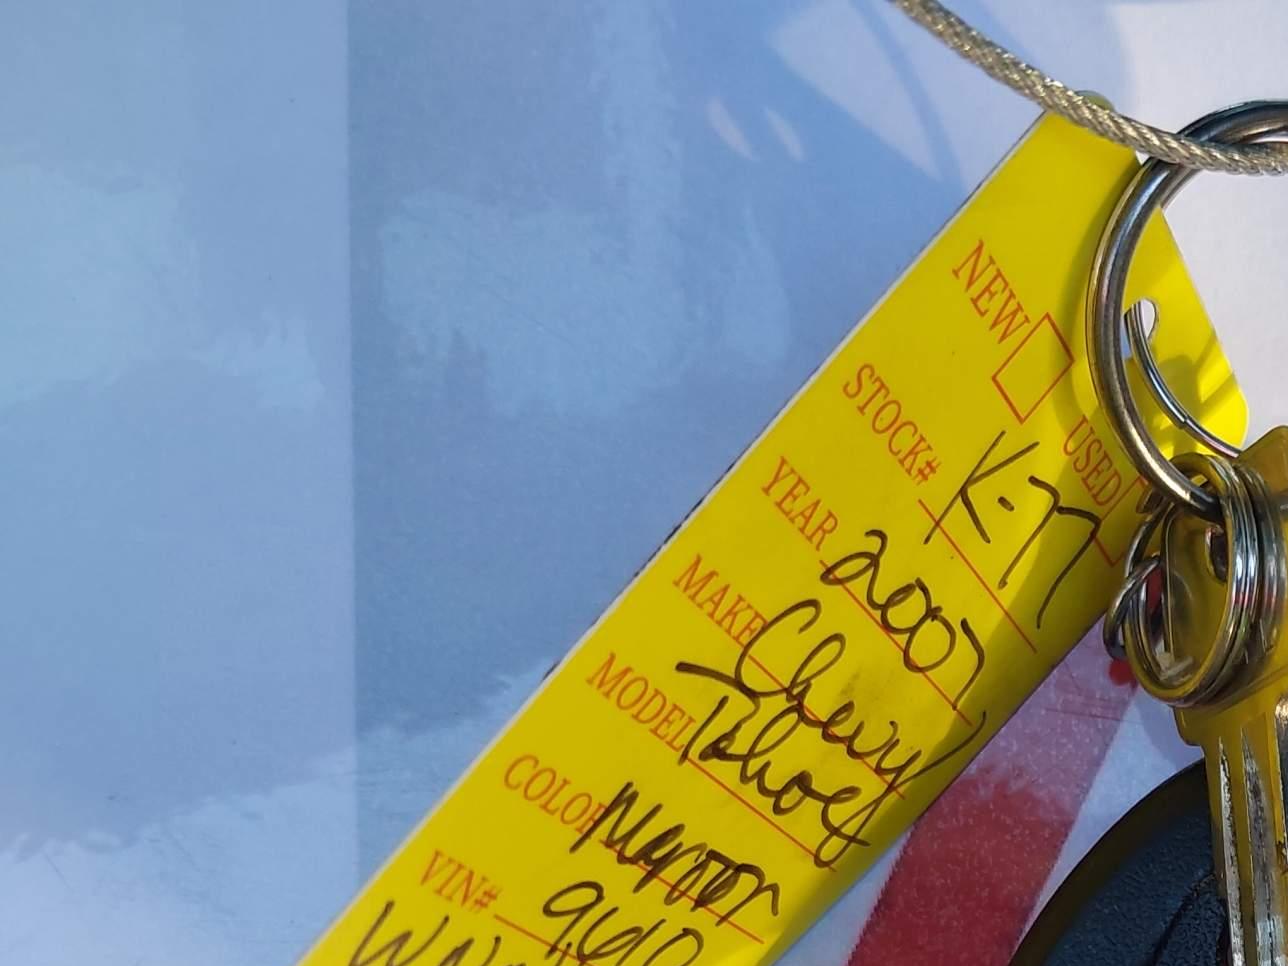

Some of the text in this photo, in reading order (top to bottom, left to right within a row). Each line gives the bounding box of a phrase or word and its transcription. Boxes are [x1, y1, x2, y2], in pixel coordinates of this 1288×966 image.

[952, 239, 1031, 345] NEW
[843, 362, 943, 488] STOCK#
[1062, 414, 1122, 508] USED
[760, 455, 840, 552] YEAR
[672, 554, 769, 651] MAKE
[819, 529, 985, 711] 2007
[585, 651, 697, 753] MODEL
[734, 597, 987, 868] Chevy
[417, 849, 499, 914] VIN#
